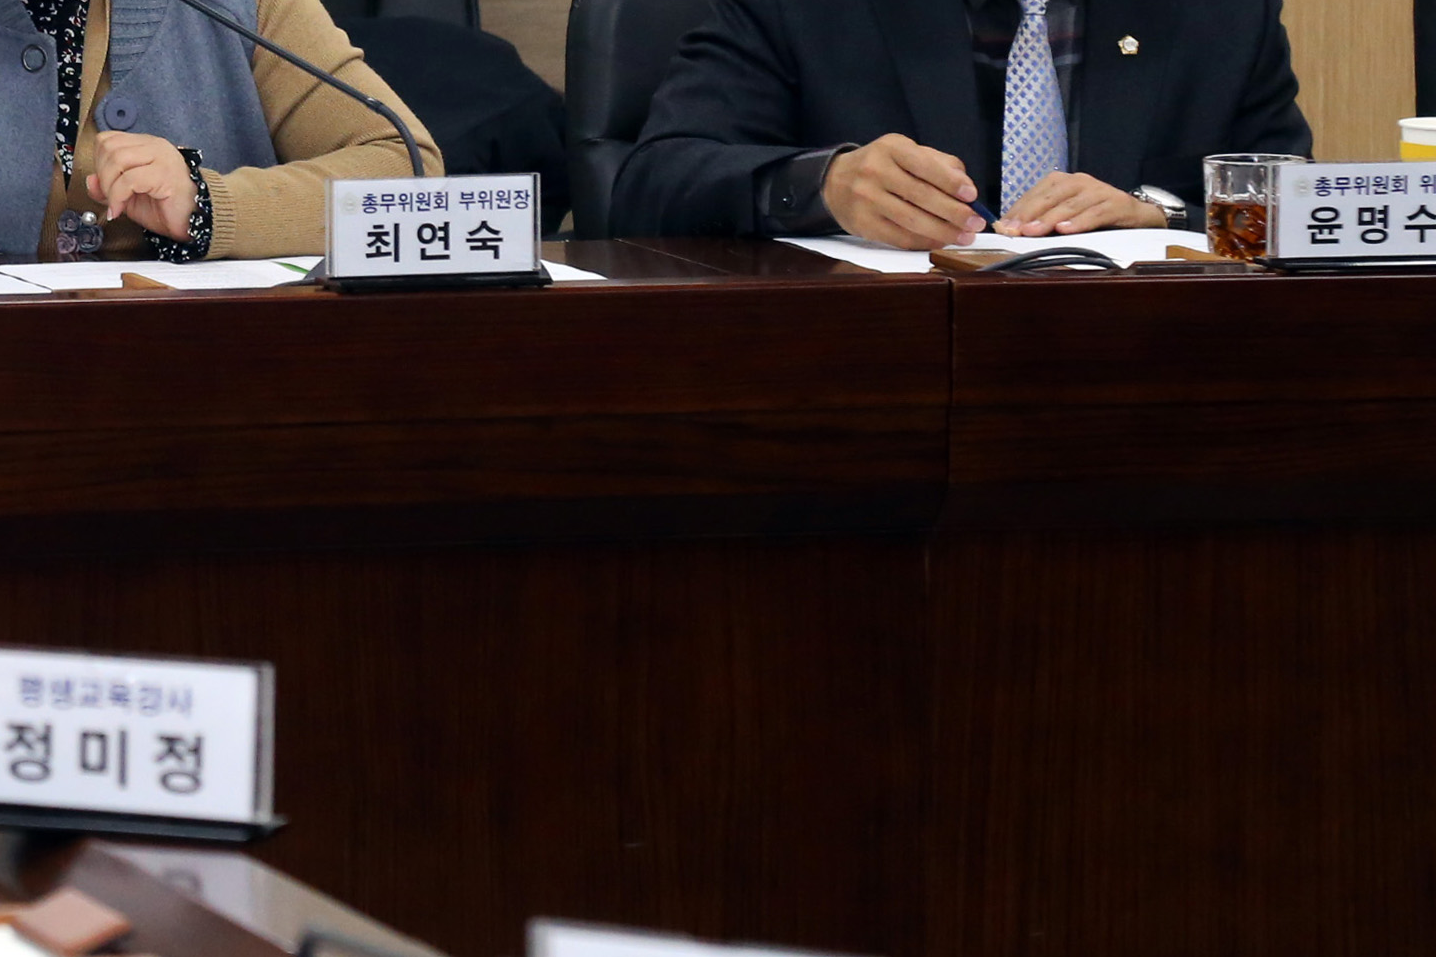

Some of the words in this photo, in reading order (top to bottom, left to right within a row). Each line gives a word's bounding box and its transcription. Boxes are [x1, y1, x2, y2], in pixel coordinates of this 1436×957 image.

[1313, 175, 1409, 197] 총무위원회
[361, 192, 449, 214] 총무위원회
[458, 189, 531, 211] 부위원장
